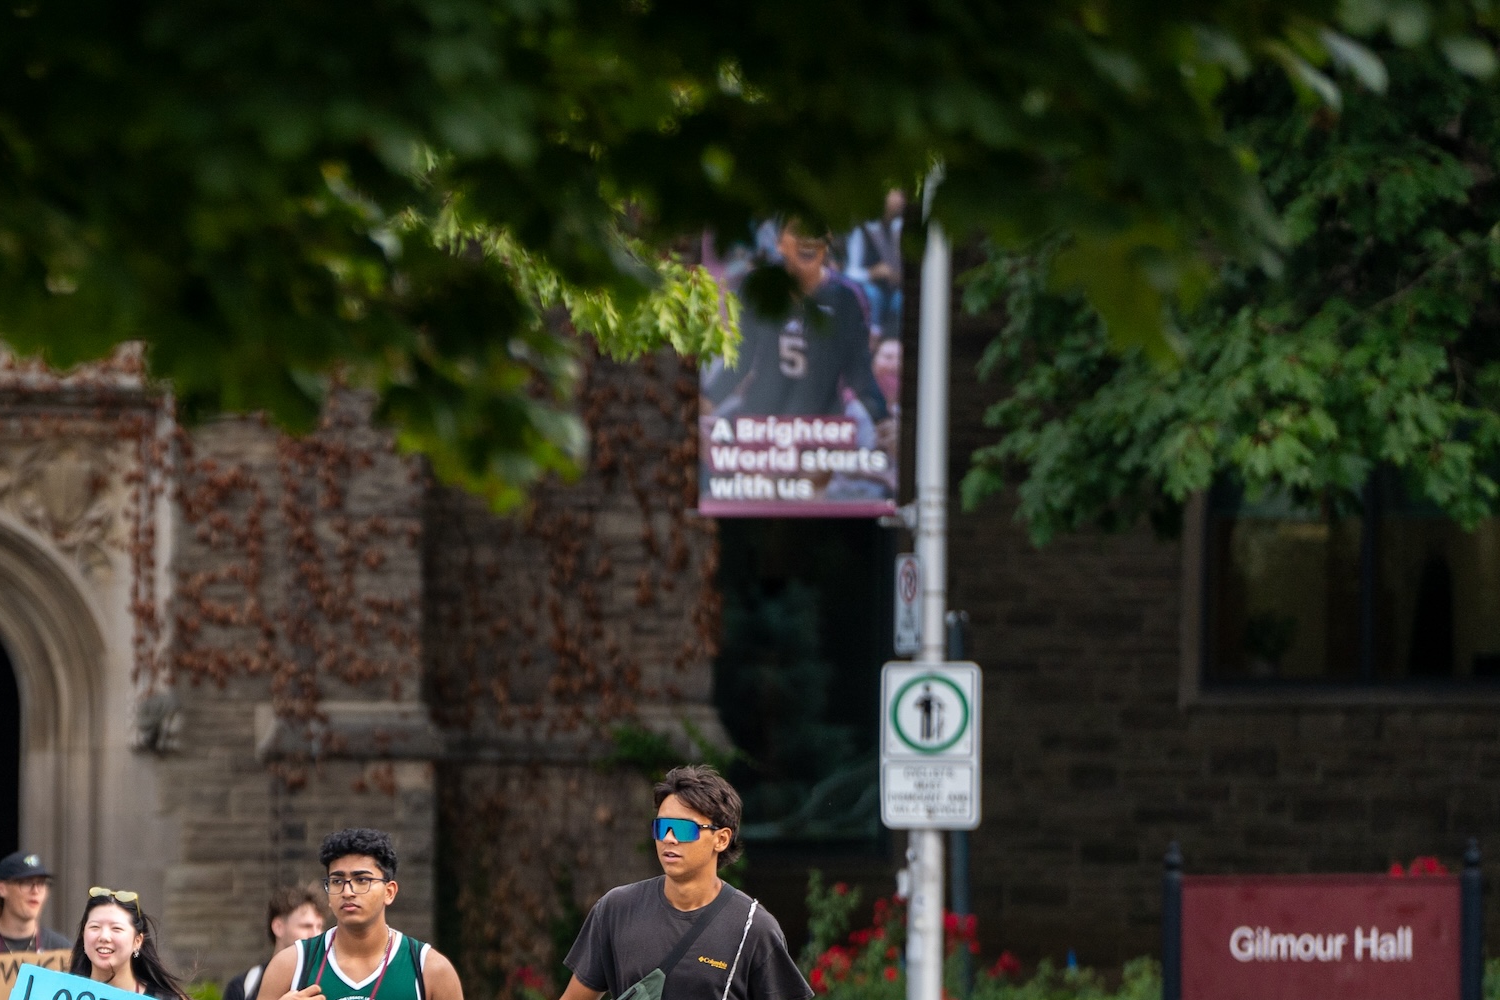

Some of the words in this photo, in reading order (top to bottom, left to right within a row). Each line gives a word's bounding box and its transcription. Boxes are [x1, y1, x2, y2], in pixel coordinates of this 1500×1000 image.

[778, 334, 808, 378] 5
[710, 418, 734, 443] A
[735, 417, 854, 447] Brighter
[710, 446, 798, 471] World
[802, 447, 888, 471] starts
[710, 475, 775, 500] with
[778, 478, 814, 499] us
[1229, 925, 1348, 963] Gilmour
[1354, 925, 1414, 962] Hall
